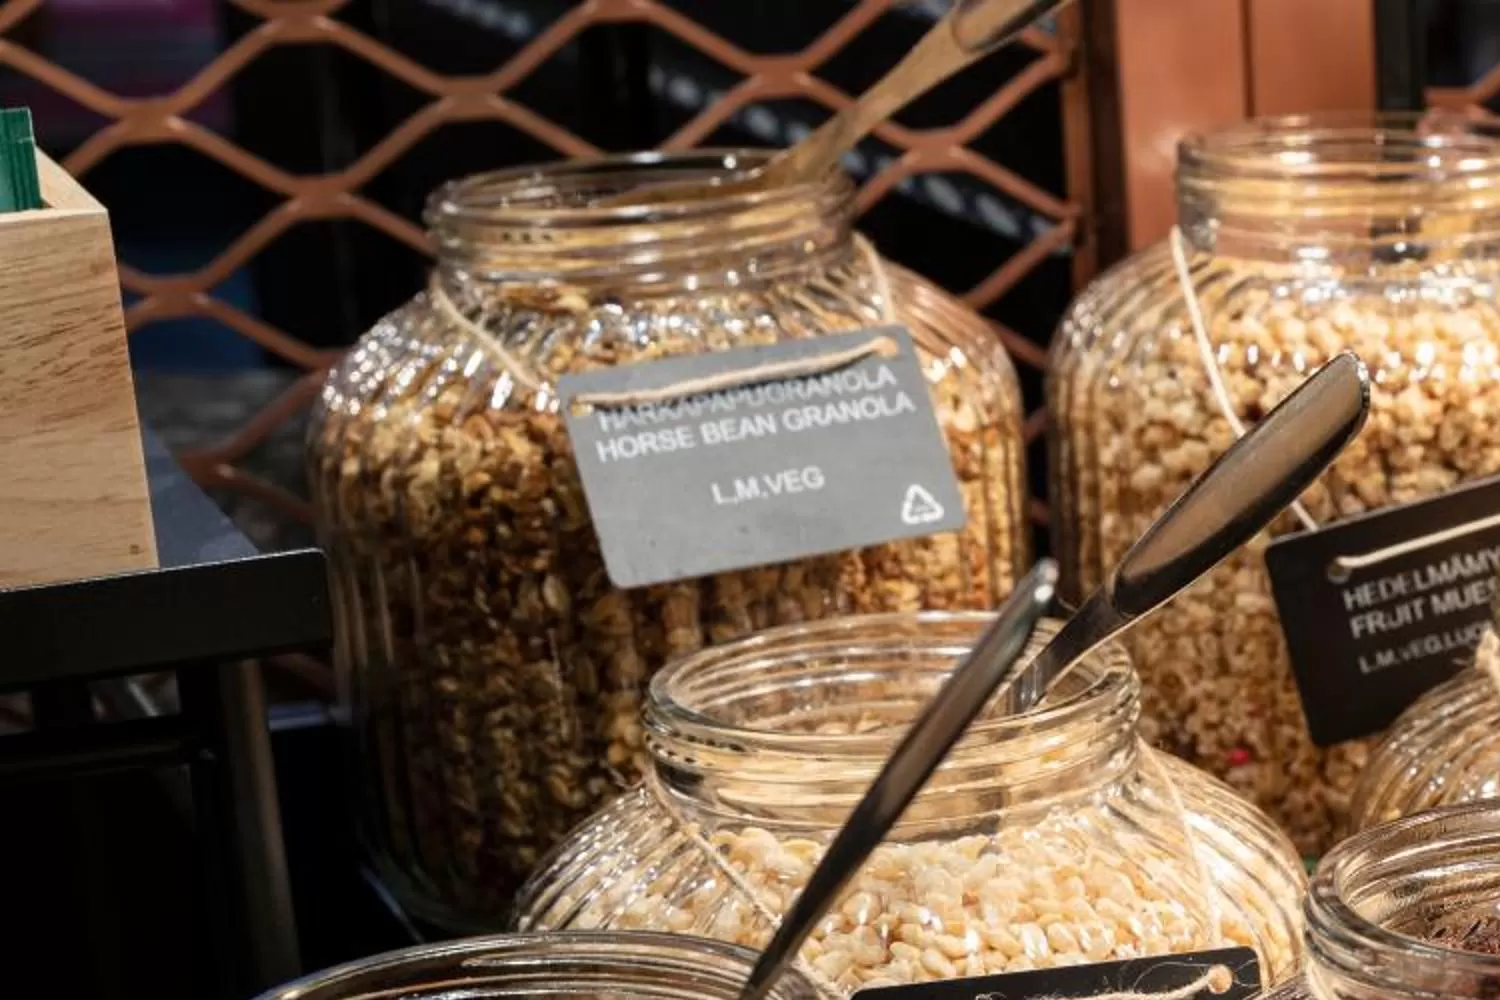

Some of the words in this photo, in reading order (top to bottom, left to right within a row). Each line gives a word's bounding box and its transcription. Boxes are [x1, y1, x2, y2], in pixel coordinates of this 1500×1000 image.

[596, 426, 697, 463] HORSE
[701, 412, 777, 446] BEAN
[782, 390, 917, 431] GRANOLA
[1349, 599, 1425, 640] FRUIT
